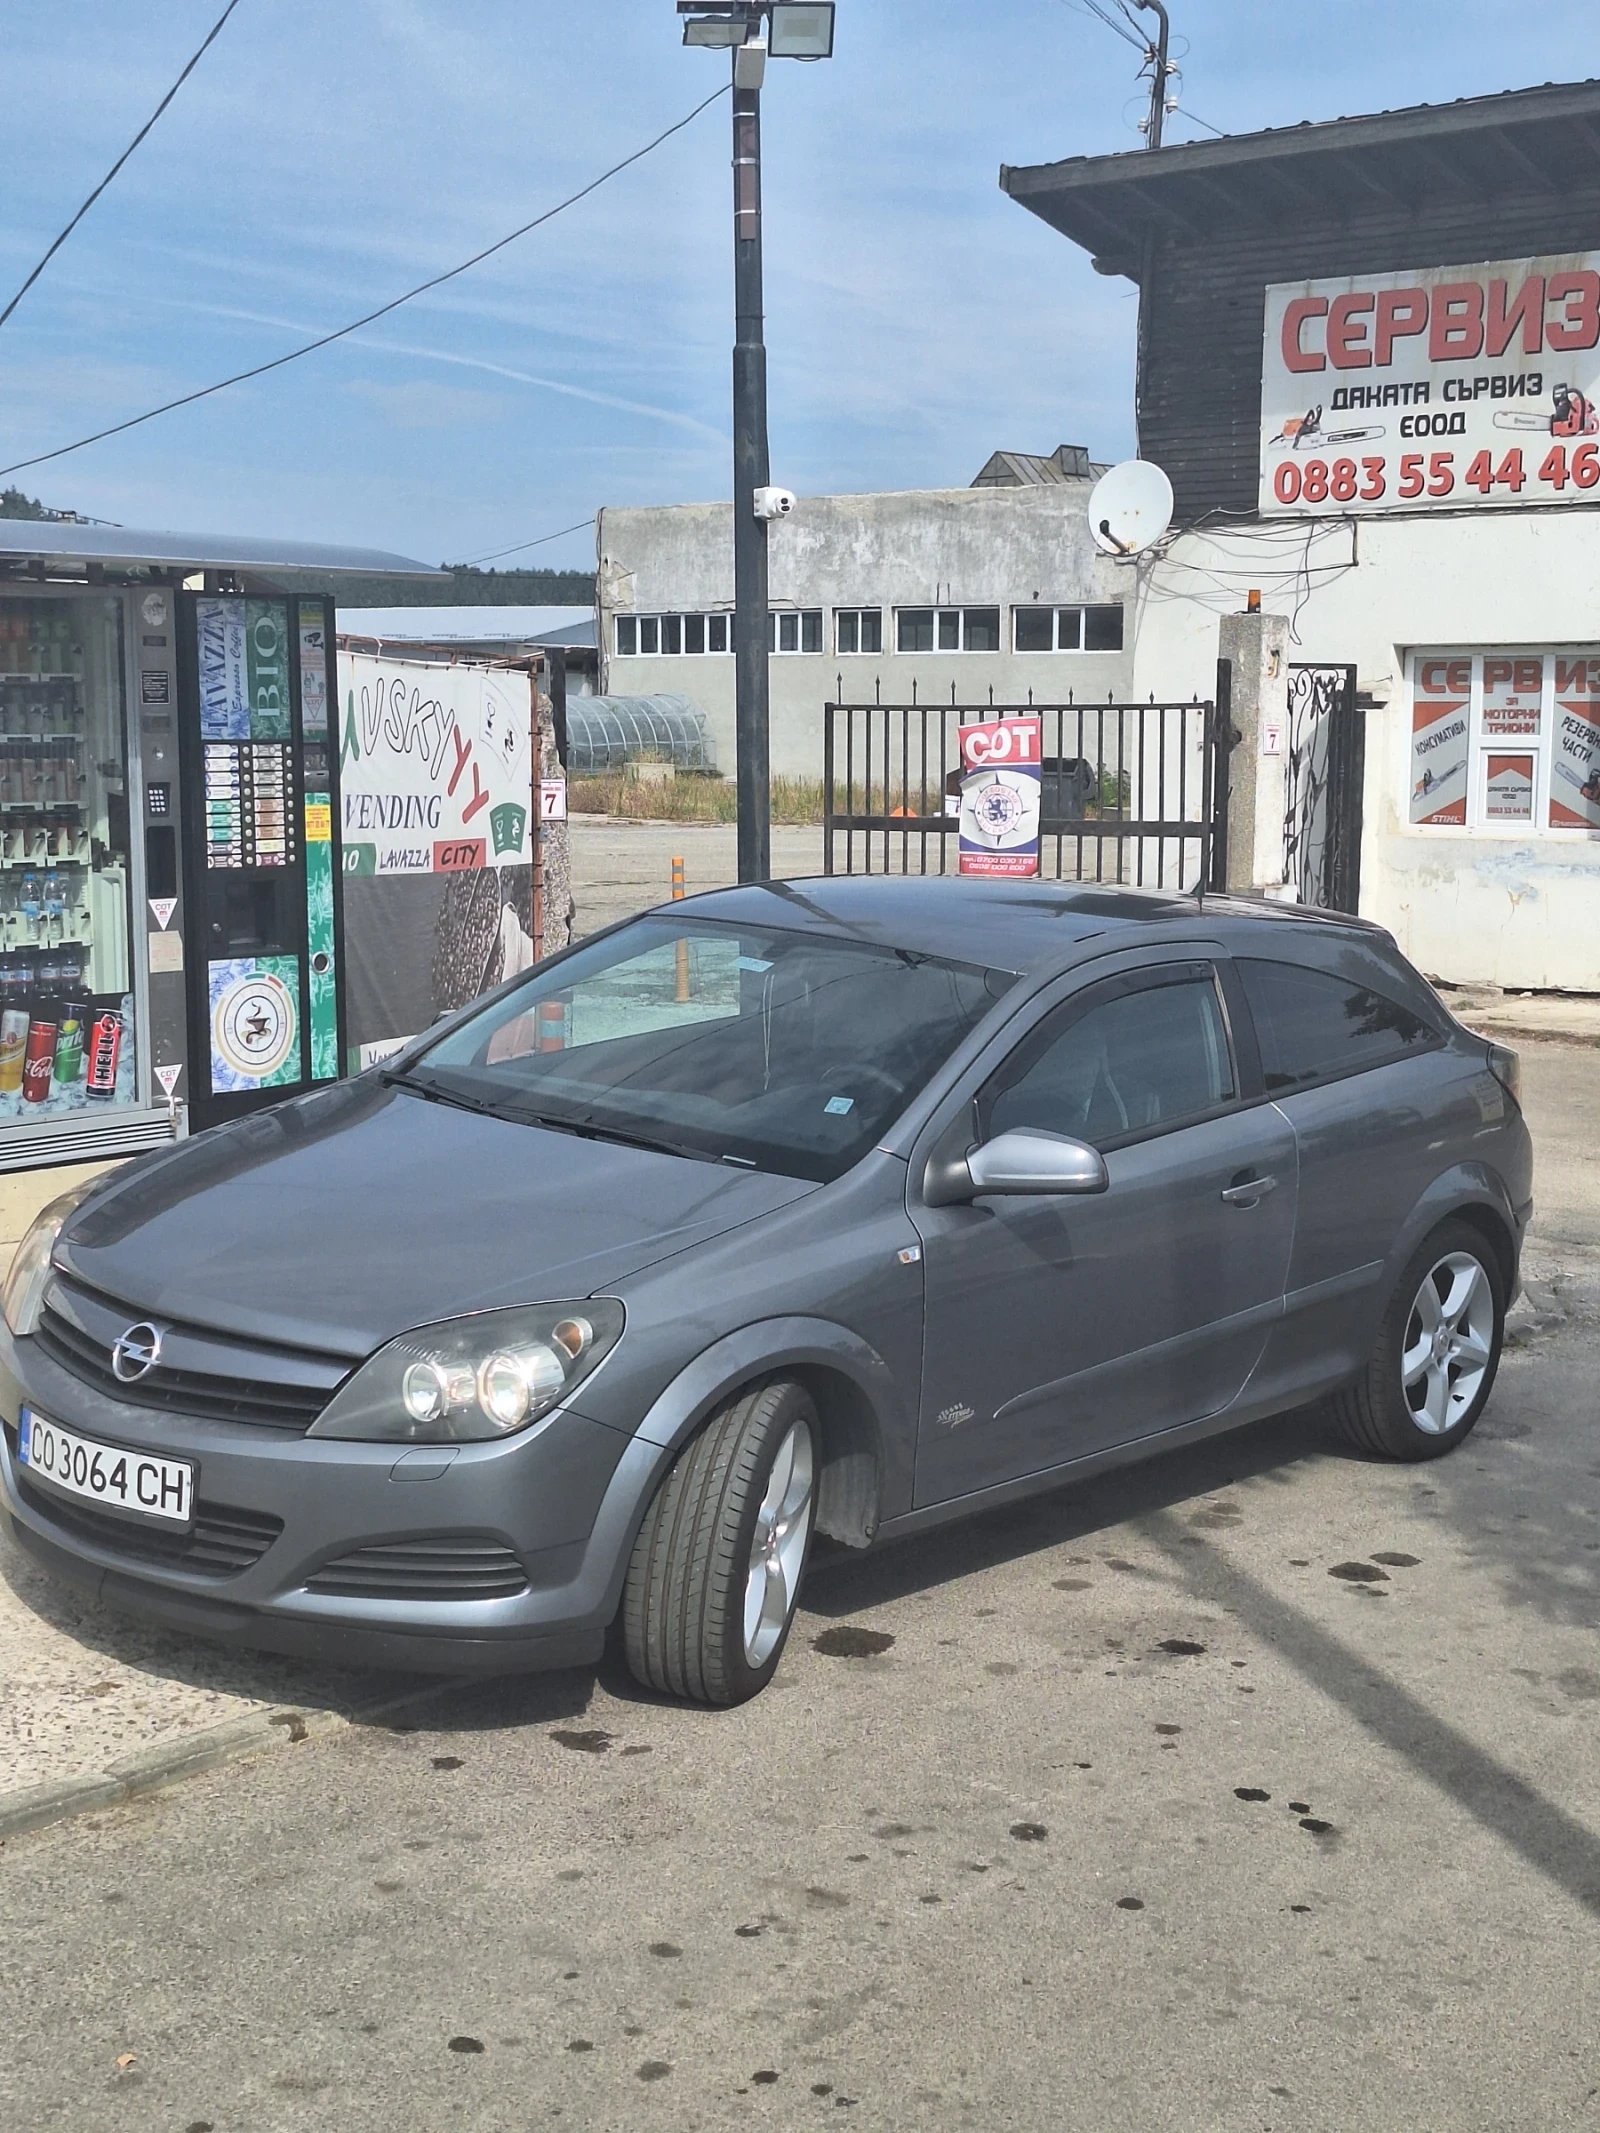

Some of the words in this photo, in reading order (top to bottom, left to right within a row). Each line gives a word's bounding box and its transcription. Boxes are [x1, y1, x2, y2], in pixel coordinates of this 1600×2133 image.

[1281, 270, 1600, 374] СЕРВИЗ
[1331, 381, 1430, 411] ДАКАТА
[1443, 372, 1543, 402] СЪРВИЗ
[1400, 411, 1466, 438] ЕООД
[1274, 456, 1386, 504] 0883
[1397, 451, 1454, 498] 55
[1465, 447, 1526, 494] 44
[1537, 442, 1600, 489] 46
[202, 609, 229, 729] LAVAZZA
[254, 616, 281, 717] BIO
[1483, 708, 1541, 720] МОТОРНИ
[1505, 697, 1519, 706] ЗА
[1269, 733, 1277, 750] 7
[1415, 719, 1467, 757] КОНСУМАТИВИ
[1487, 722, 1536, 734] ТРИОНИ
[1561, 715, 1600, 750] РЕЗЕРВН
[1562, 735, 1594, 764] ЧАСТИ
[345, 794, 442, 829] VENDING
[544, 793, 557, 814] 7
[1431, 814, 1462, 823] STIHL
[342, 849, 360, 871] IO
[379, 848, 430, 870] LAVAZZA
[441, 843, 480, 867] CITY
[95, 1035, 115, 1084] HELL
[32, 1422, 55, 1472] CO
[58, 1438, 128, 1500] 3064
[137, 1462, 184, 1512] CH
